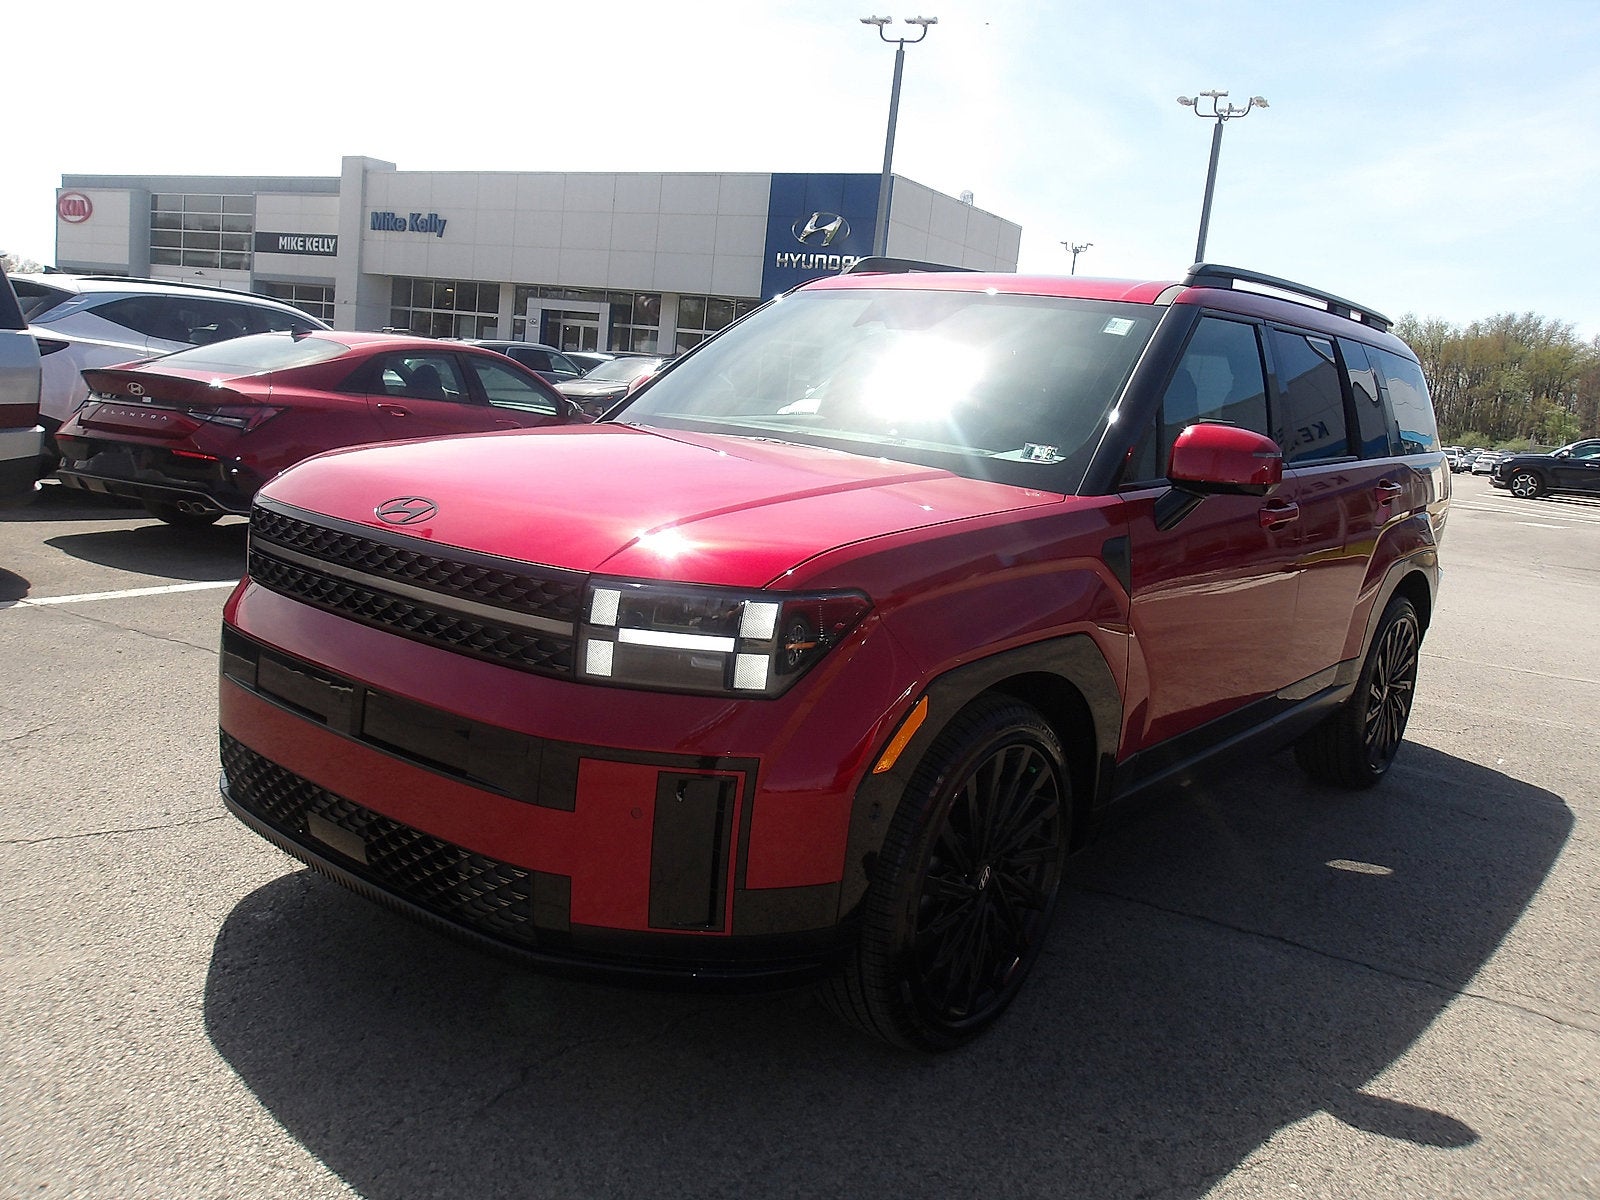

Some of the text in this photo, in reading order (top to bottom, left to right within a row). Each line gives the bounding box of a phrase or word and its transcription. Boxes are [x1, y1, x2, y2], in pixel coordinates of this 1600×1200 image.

[370, 212, 447, 238] Mike Kelly
[278, 236, 336, 252] MIKE KELLY
[102, 408, 168, 421] ELANTRA
